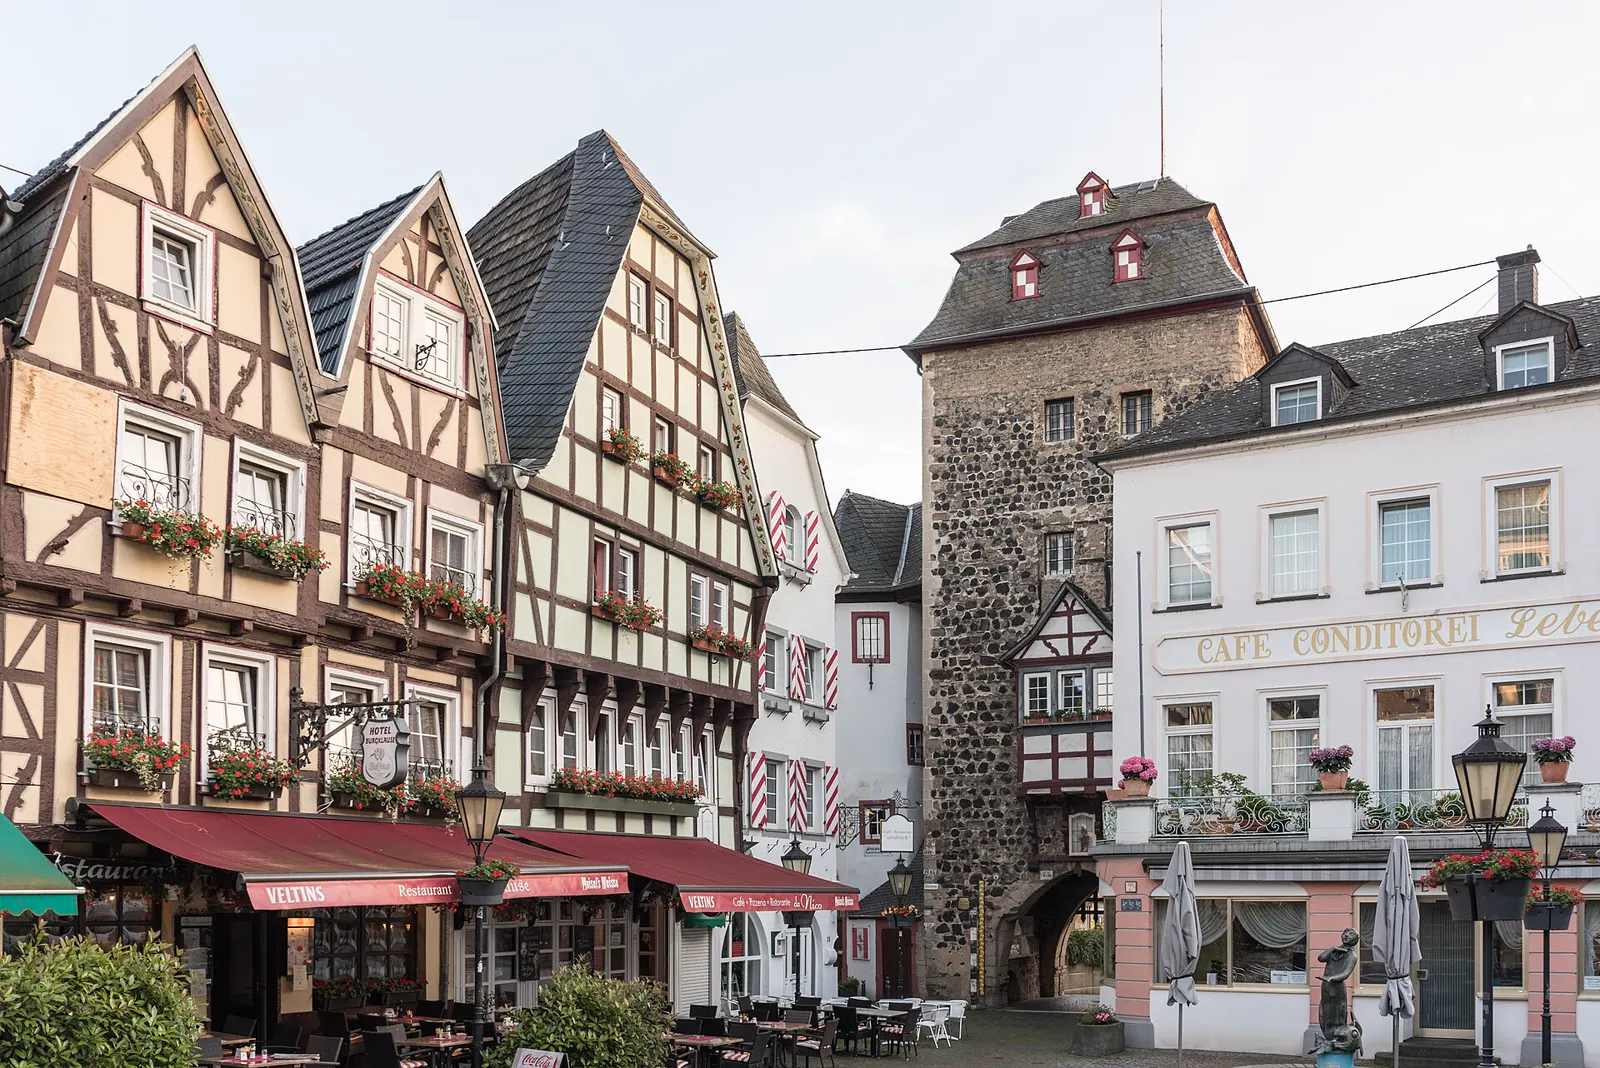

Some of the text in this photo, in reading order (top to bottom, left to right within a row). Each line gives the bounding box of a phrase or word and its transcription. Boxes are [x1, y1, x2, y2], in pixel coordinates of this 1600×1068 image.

[1197, 632, 1273, 665] CAFE
[1292, 613, 1481, 657] CONDITOREI
[369, 726, 392, 736] HOTEL
[265, 885, 326, 904] VELTINS
[398, 884, 453, 898] Restaurant
[688, 895, 716, 909] VELTINS
[800, 893, 823, 910] Nico
